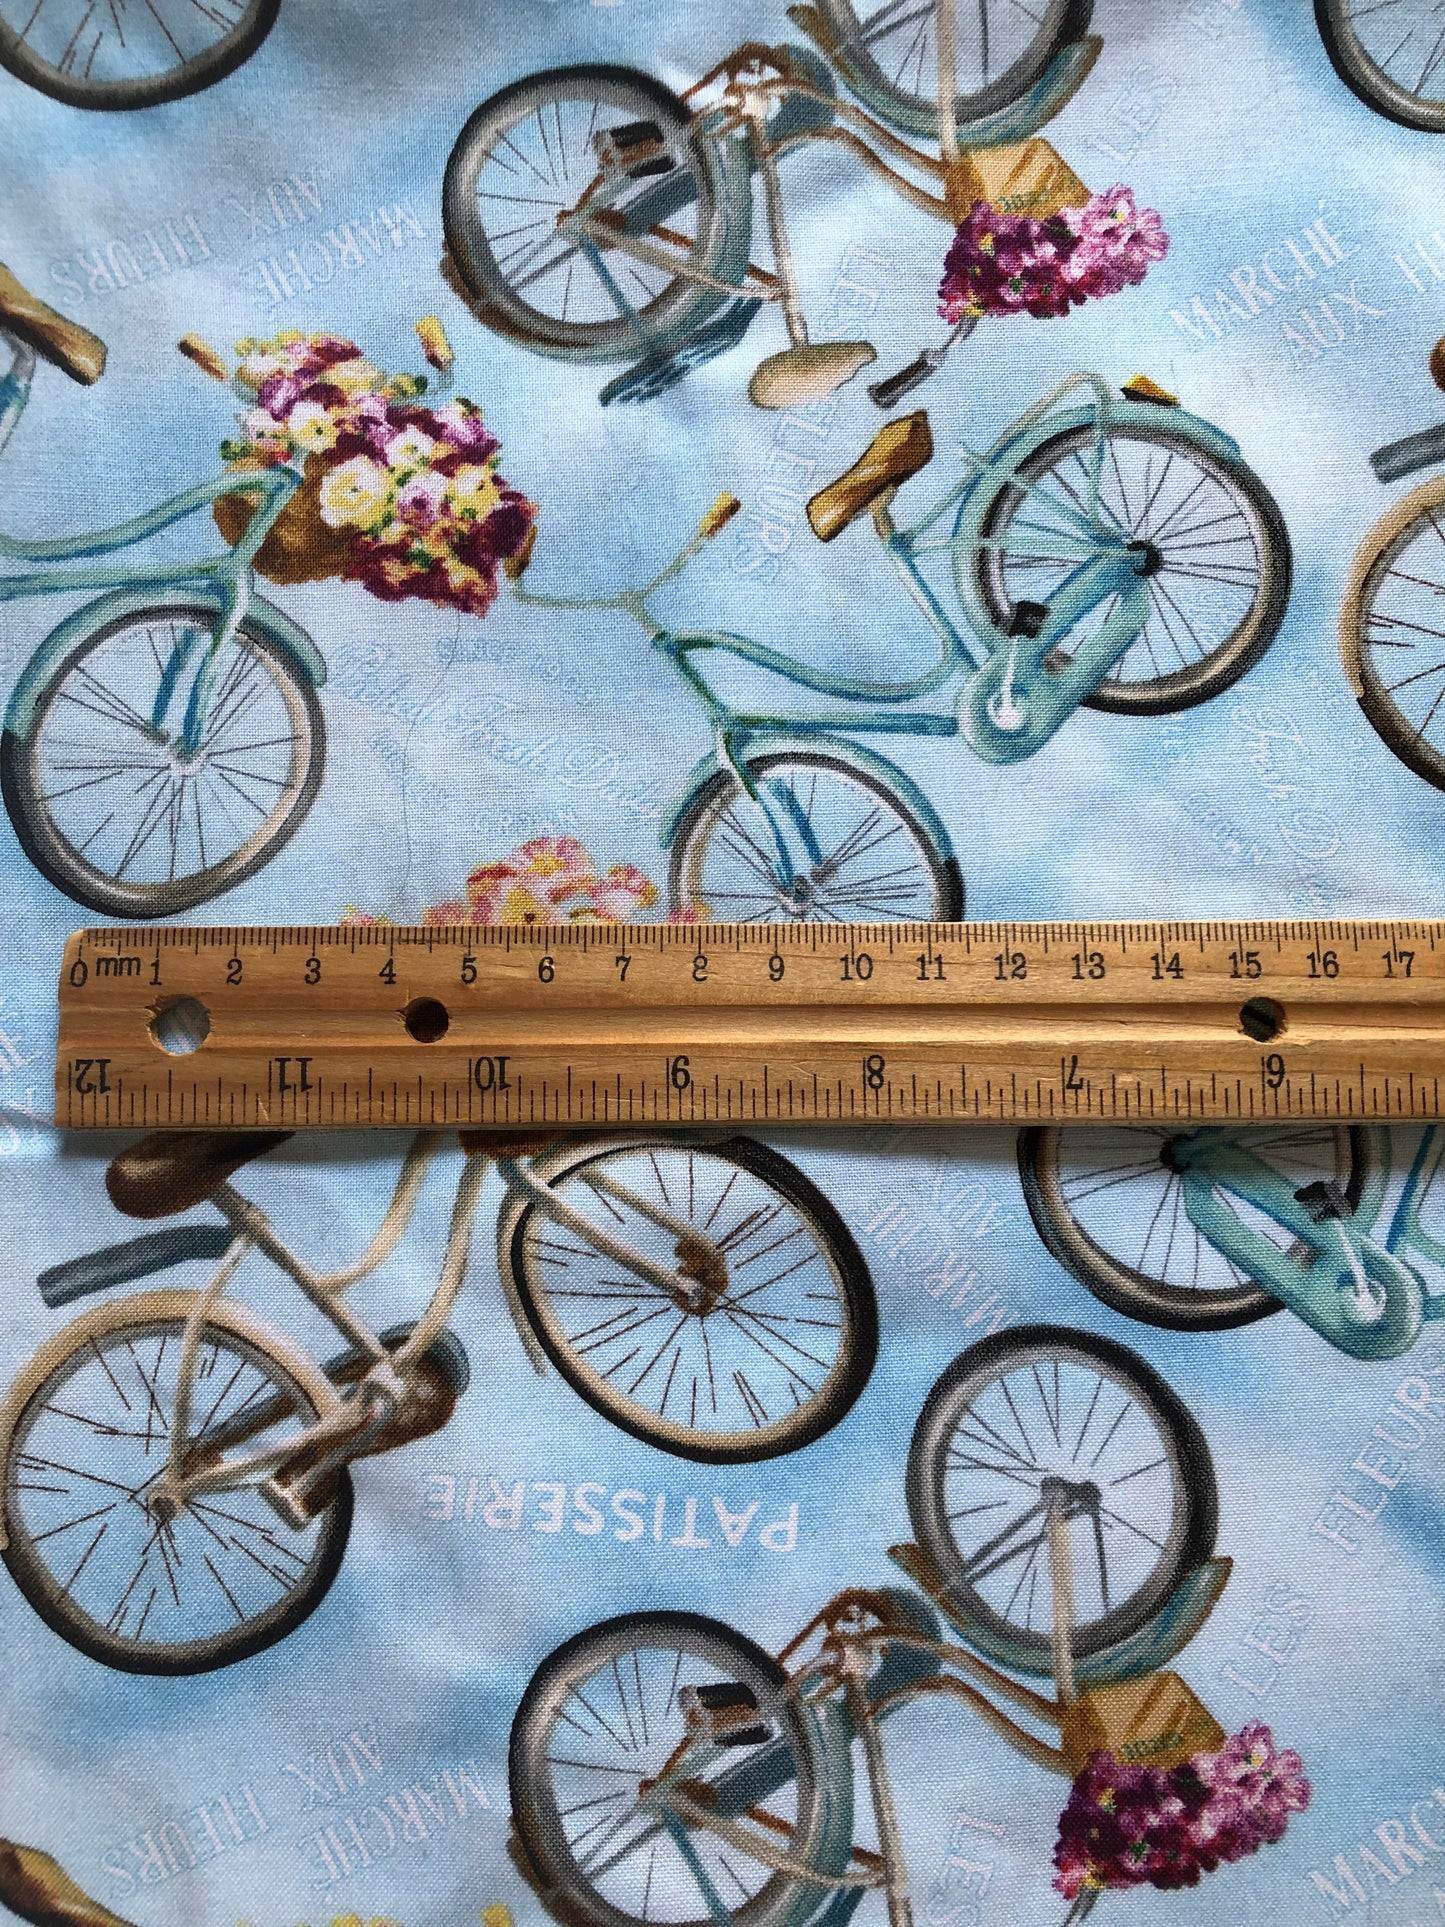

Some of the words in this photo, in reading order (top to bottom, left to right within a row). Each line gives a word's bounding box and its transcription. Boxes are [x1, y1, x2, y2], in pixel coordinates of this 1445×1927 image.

[227, 168, 322, 241] AUX
[1169, 200, 1361, 343] MARCHÉ
[1281, 277, 1392, 360] AUX
[70, 958, 88, 987] 0
[96, 957, 141, 977] mm
[149, 959, 162, 986] 1
[227, 958, 243, 985] 2
[305, 958, 321, 985] 3
[379, 958, 397, 985] 4
[461, 957, 477, 984] 5
[538, 957, 554, 983] 6
[616, 956, 631, 982] 7
[693, 955, 708, 982] 8
[769, 955, 785, 981] 9
[840, 953, 873, 981] 10
[917, 954, 947, 981] 11
[994, 953, 1027, 980] 12
[1071, 952, 1105, 980] 13
[1151, 952, 1184, 979] 14
[1228, 951, 1262, 979] 15
[1307, 951, 1339, 979] 16
[1382, 951, 1415, 978] 17
[75, 1059, 111, 1094] 12
[275, 1058, 313, 1092] 11
[474, 1056, 511, 1091] 10
[866, 1055, 885, 1089] 8
[1066, 1055, 1084, 1090] 7
[910, 1152, 1016, 1238] AUX
[423, 1474, 800, 1553] PATISSERIE
[1221, 1579, 1315, 1697] LES
[280, 1720, 385, 1811] AUX
[101, 1783, 270, 1900] FLEURS
[298, 1758, 491, 1904] MARCHÉ
